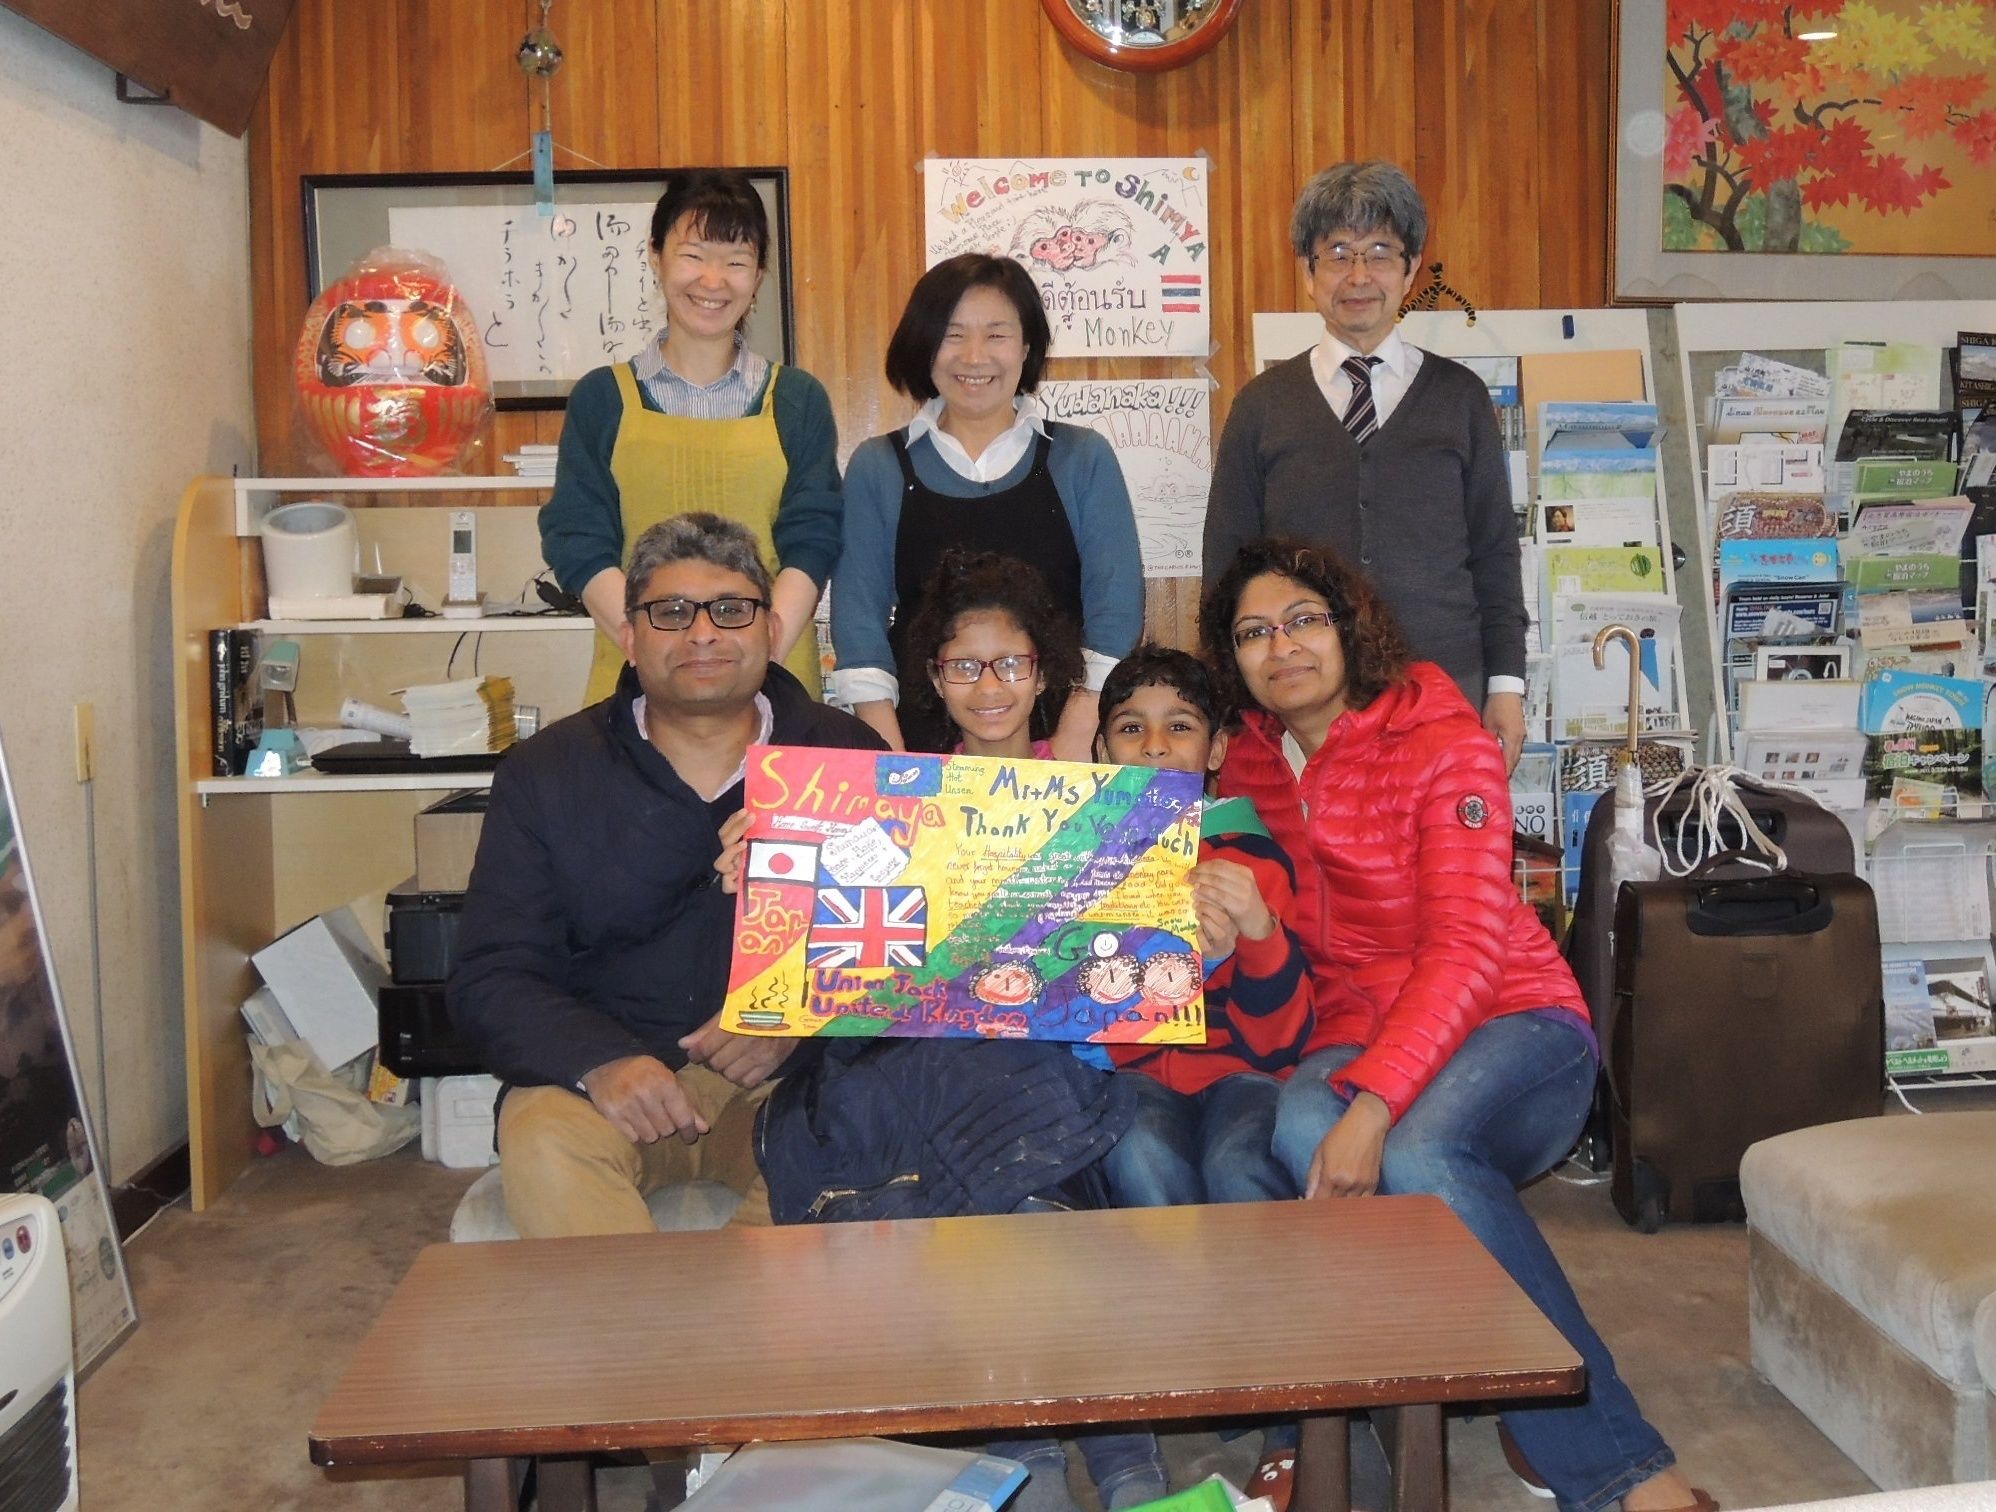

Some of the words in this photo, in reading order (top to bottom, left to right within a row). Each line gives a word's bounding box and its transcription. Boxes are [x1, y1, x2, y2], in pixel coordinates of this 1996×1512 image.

[938, 168, 1067, 224] Welcome
[960, 805, 1030, 837] Thank
[1042, 808, 1084, 833] You
[811, 968, 886, 993] Union
